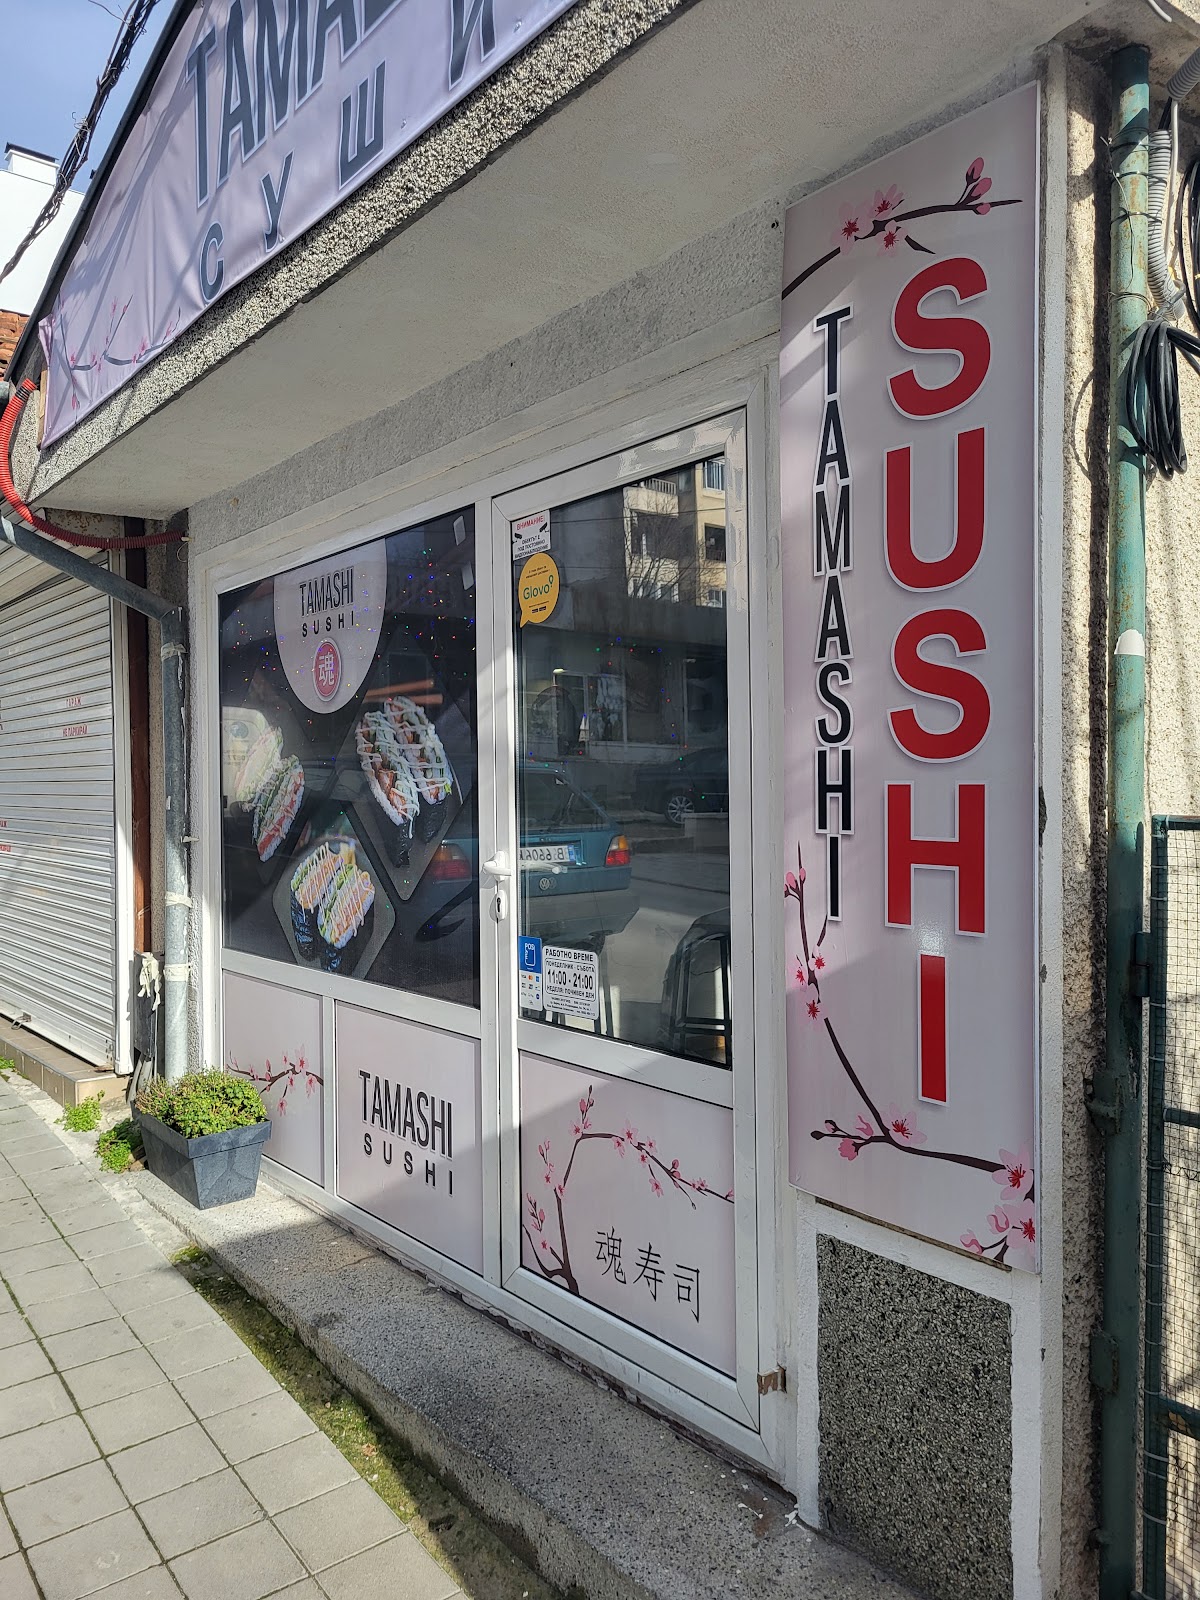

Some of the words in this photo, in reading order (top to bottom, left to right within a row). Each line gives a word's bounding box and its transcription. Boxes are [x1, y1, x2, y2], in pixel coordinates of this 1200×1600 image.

[299, 566, 354, 617] TAMASHI
[523, 583, 550, 600] Glovo
[814, 304, 852, 920] TAMASHI
[302, 610, 354, 638] SUSHI
[318, 651, 335, 687] 魂
[887, 256, 992, 1105] SUSHI
[545, 948, 572, 960] РАБОТНО
[573, 952, 594, 962] ВРЕМЕ
[545, 960, 574, 970] ПОНЕДЕЛНИК
[577, 964, 595, 973] СЪБОТА
[547, 968, 567, 986] 11:00
[573, 972, 594, 990] 21:00
[359, 1069, 452, 1159] TAMASHI
[363, 1132, 453, 1195] SUSHI
[595, 1225, 700, 1323] 魂寿司
